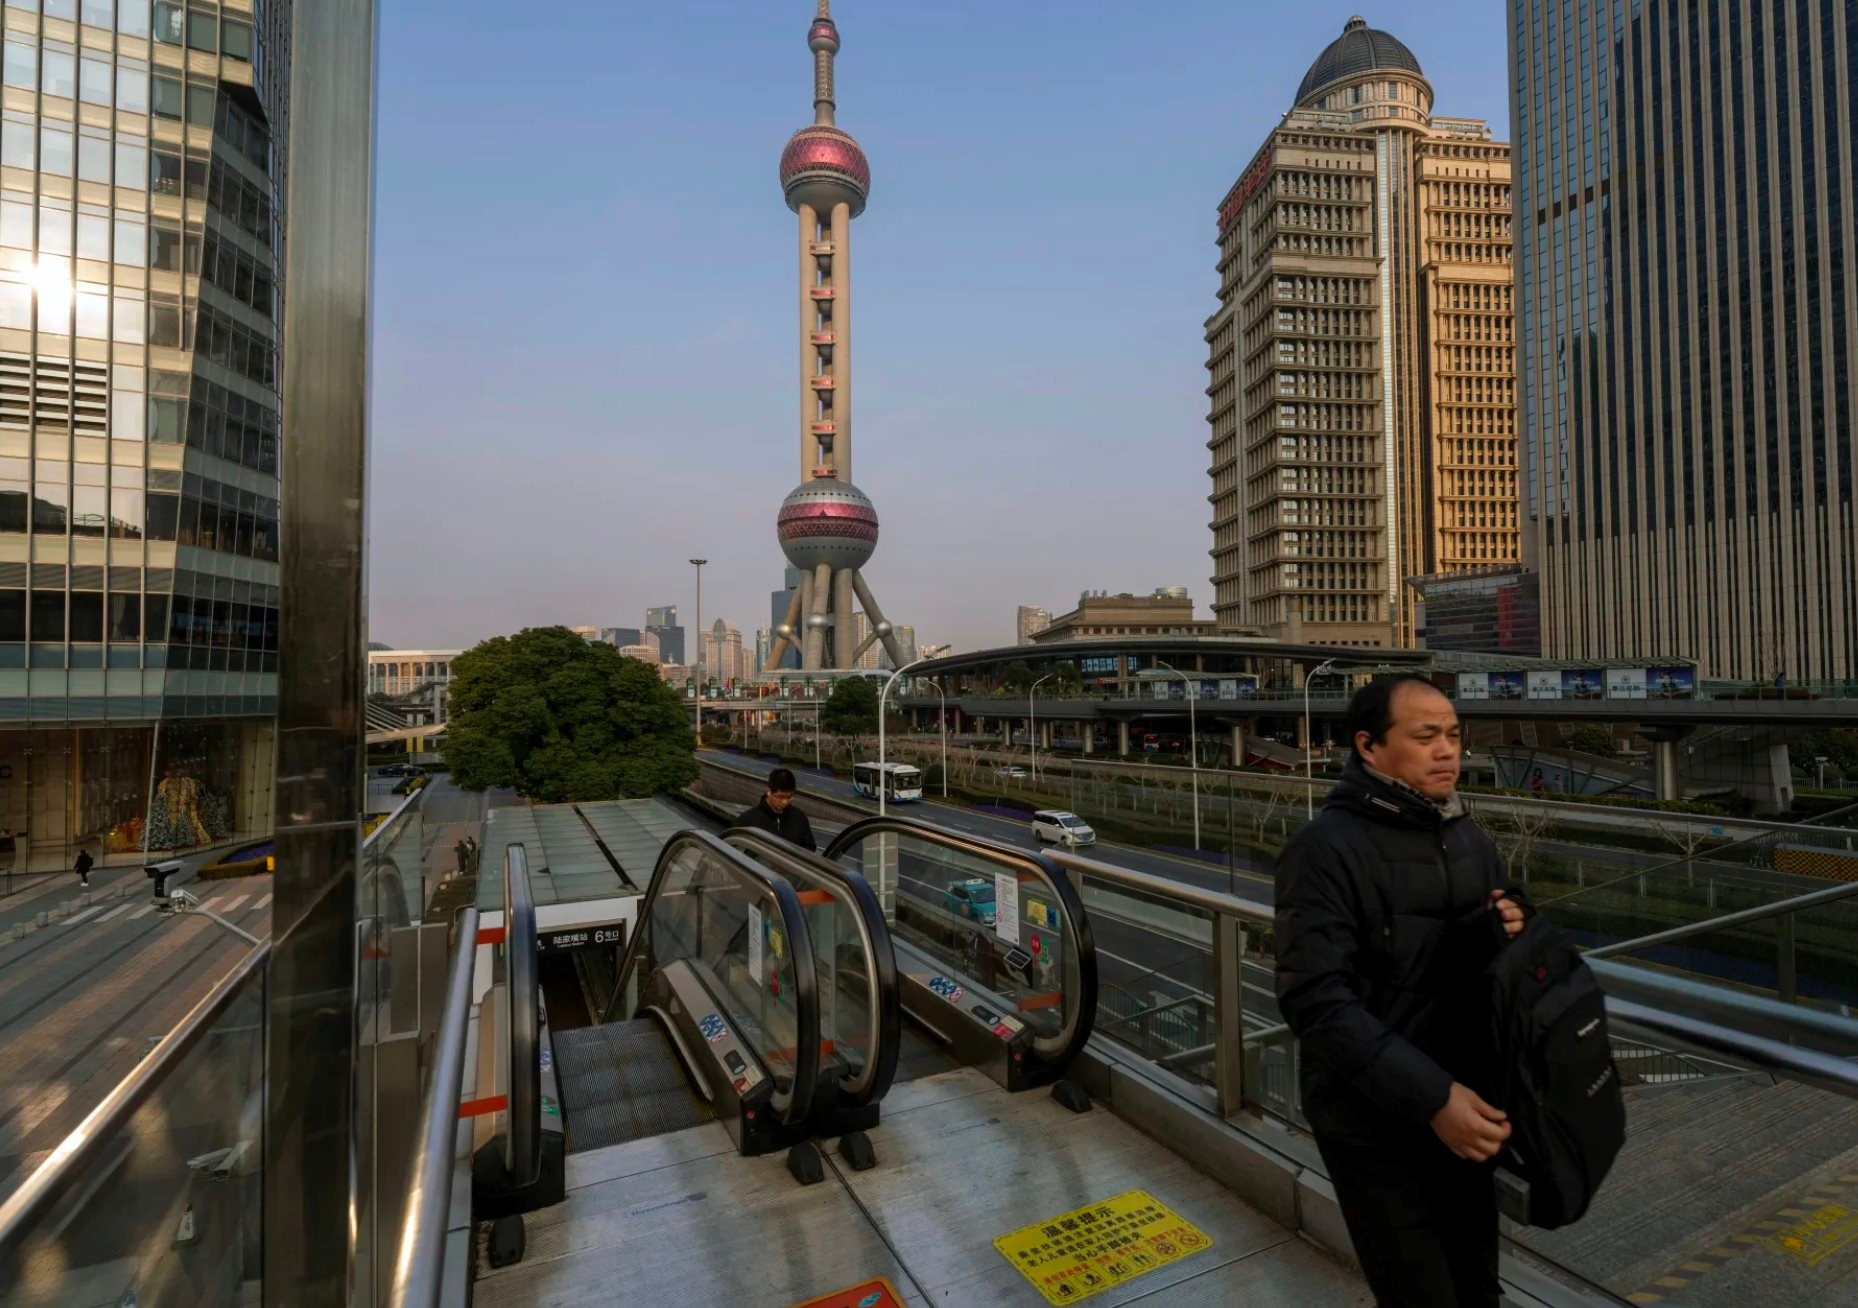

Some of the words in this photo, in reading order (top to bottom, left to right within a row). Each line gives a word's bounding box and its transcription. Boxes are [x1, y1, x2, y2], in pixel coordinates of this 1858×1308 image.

[552, 932, 588, 945] 陆家嘴站
[1041, 1206, 1115, 1237] 温馨提示
